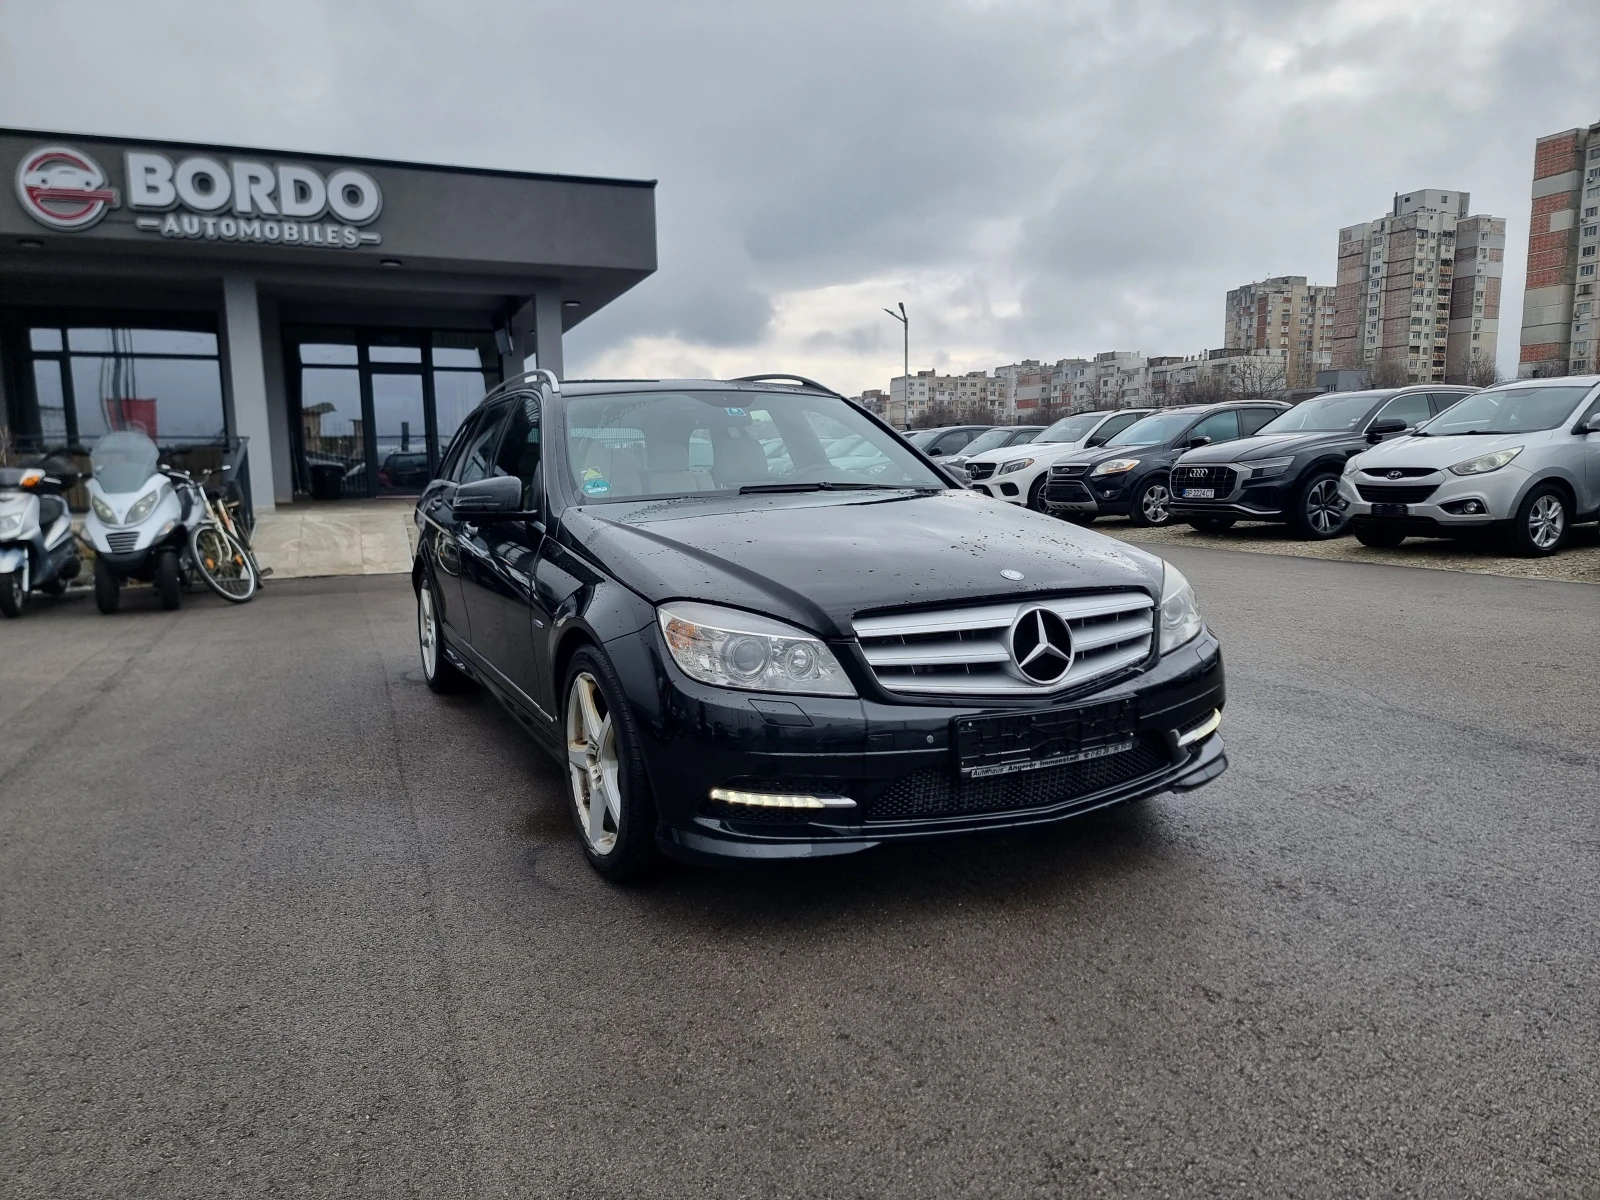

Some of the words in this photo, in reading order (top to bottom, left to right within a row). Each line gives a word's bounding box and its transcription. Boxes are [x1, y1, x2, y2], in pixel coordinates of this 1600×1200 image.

[128, 152, 379, 222] BORDO
[162, 216, 357, 246] AUTOMOBILES
[973, 767, 1004, 777] Autohaus
[1007, 762, 1036, 772] Angerer
